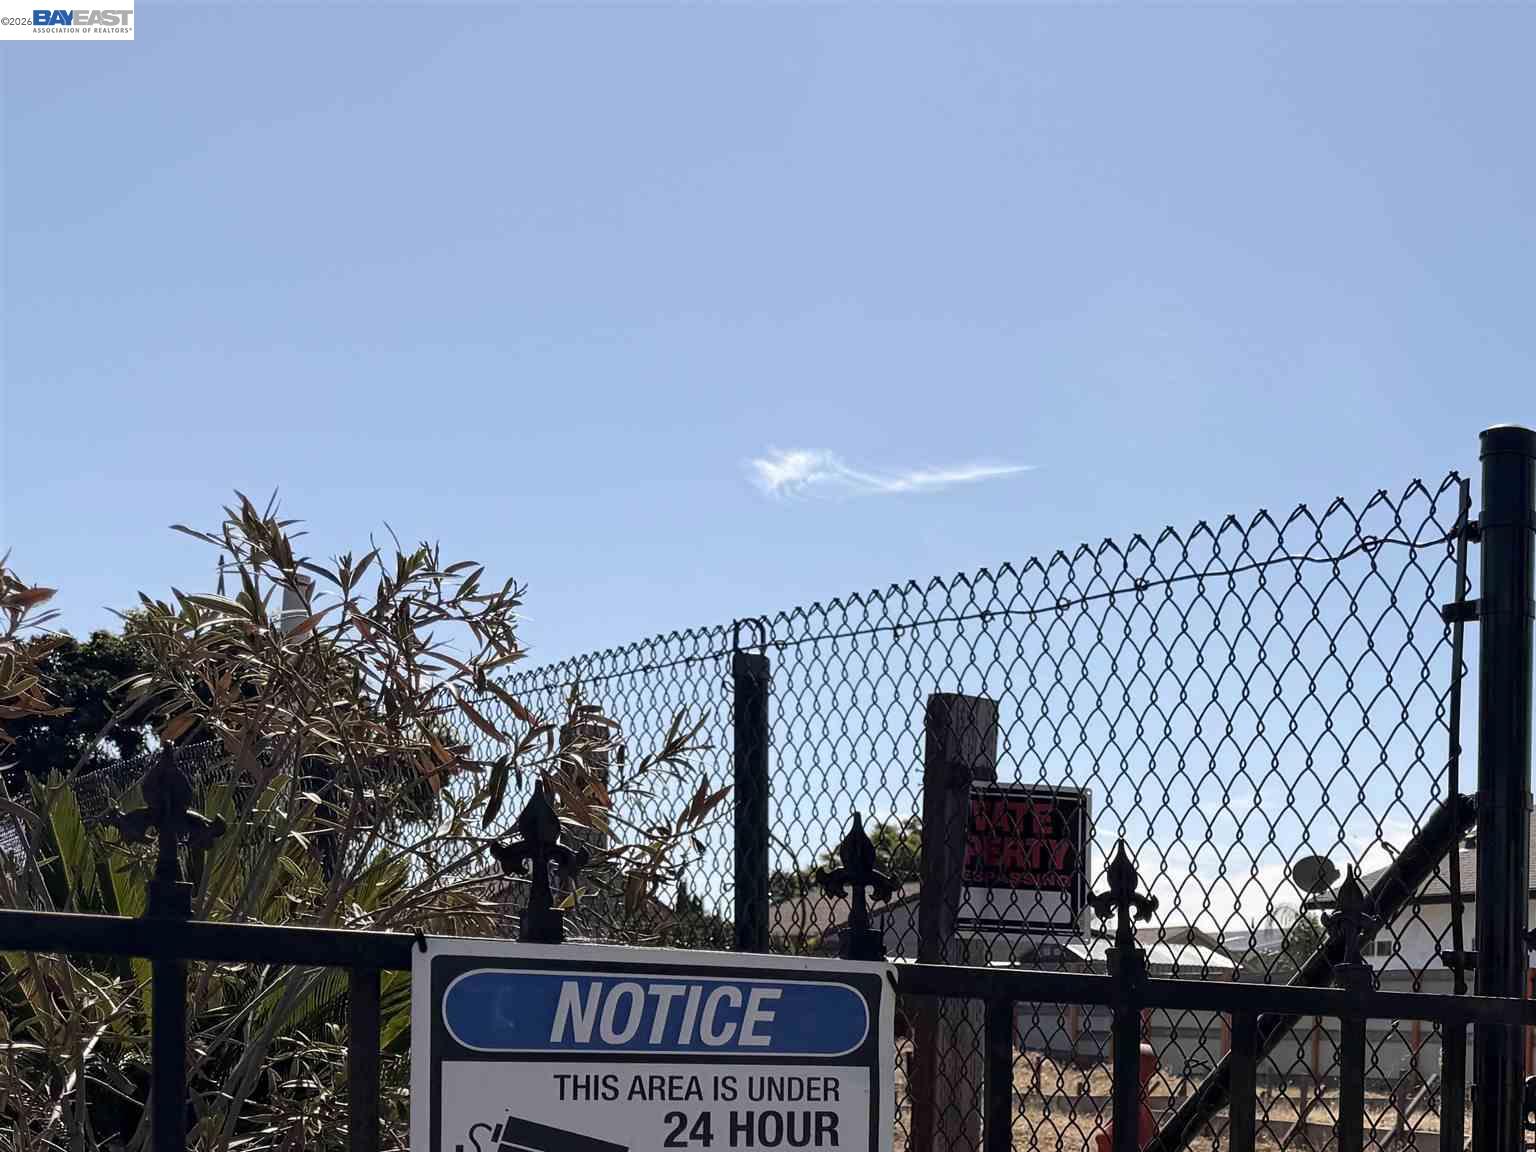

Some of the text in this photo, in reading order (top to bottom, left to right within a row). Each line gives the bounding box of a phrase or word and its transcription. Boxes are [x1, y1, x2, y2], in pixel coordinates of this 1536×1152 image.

[550, 981, 783, 1047] NOTICE
[554, 1074, 840, 1102] THIS AREA IS UNDER
[663, 1110, 840, 1148] 24 HOUR
